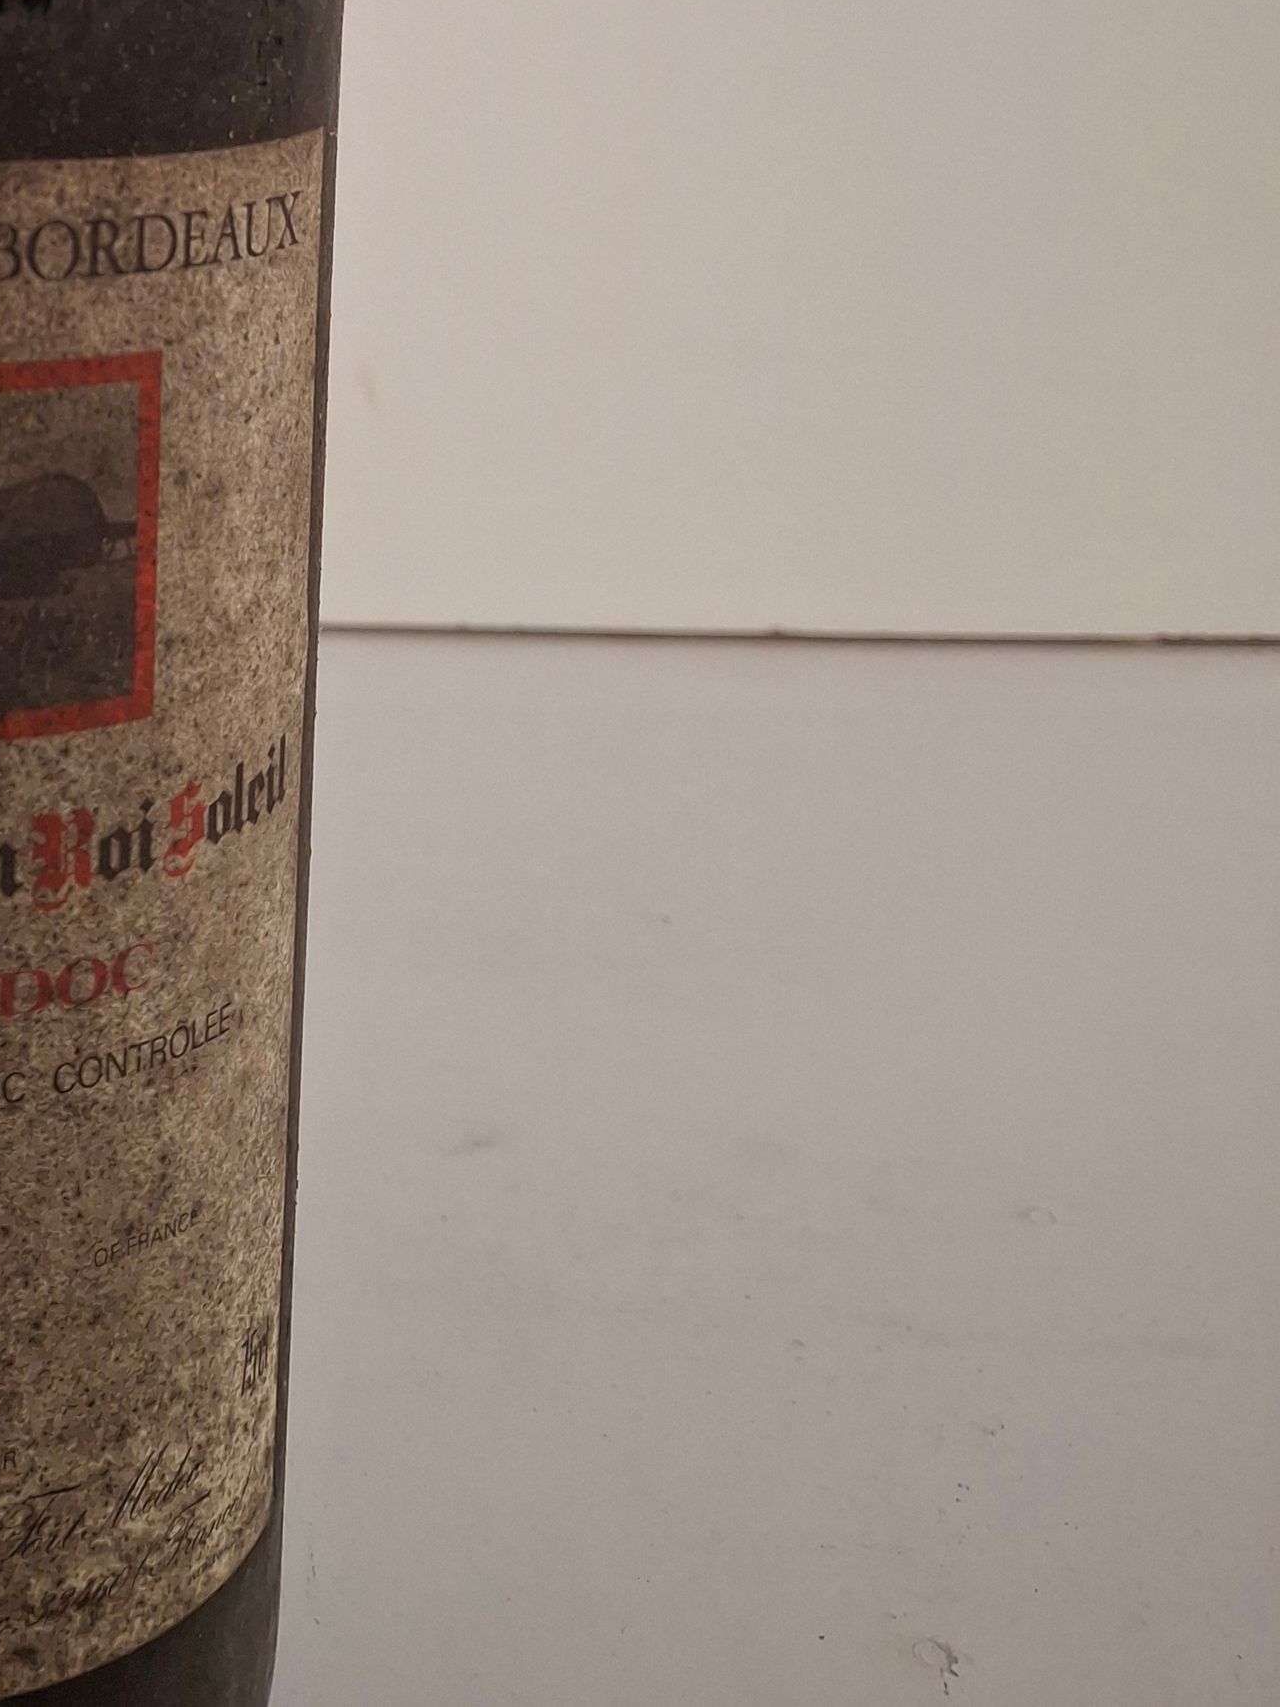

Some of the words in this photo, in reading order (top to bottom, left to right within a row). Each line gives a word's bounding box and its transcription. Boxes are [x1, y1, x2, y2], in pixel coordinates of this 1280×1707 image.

[31, 797, 158, 912] Roi
[162, 732, 288, 878] Soleil
[94, 1240, 121, 1267] OF
[126, 1208, 199, 1256] FRANCE
